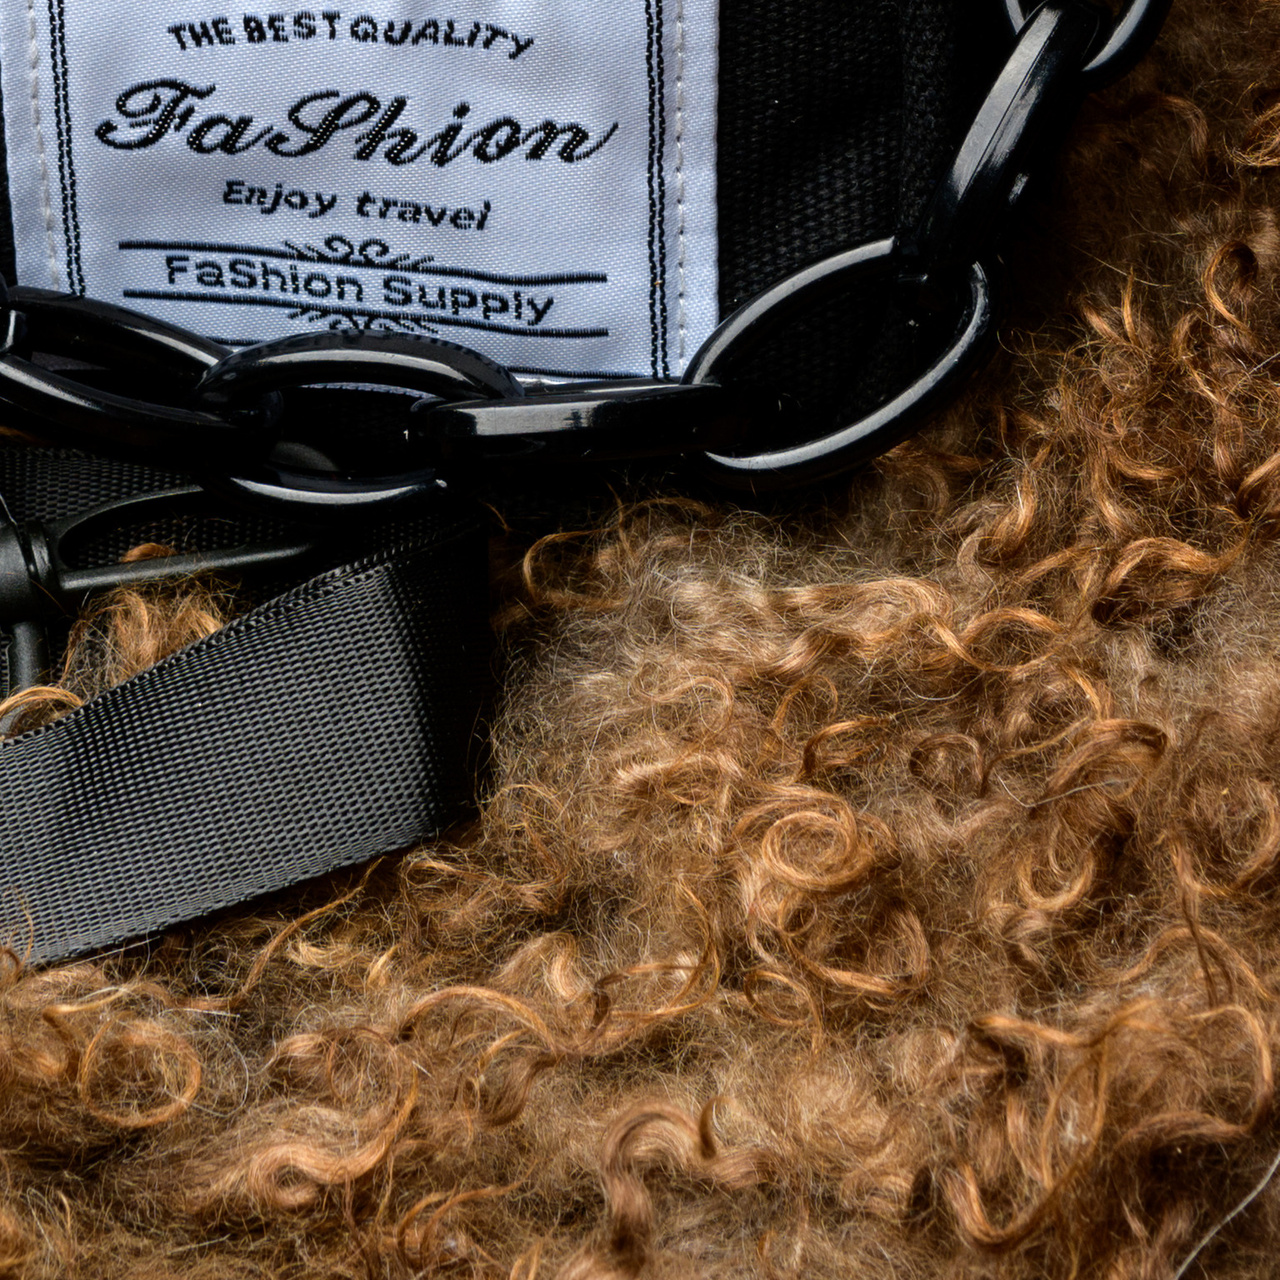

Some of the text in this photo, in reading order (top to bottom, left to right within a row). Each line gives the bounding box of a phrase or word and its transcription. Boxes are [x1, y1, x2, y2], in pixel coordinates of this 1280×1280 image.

[167, 10, 536, 59] THE BEST QUALITY
[223, 178, 493, 232] Enjoy travel
[382, 275, 556, 326] Supply
